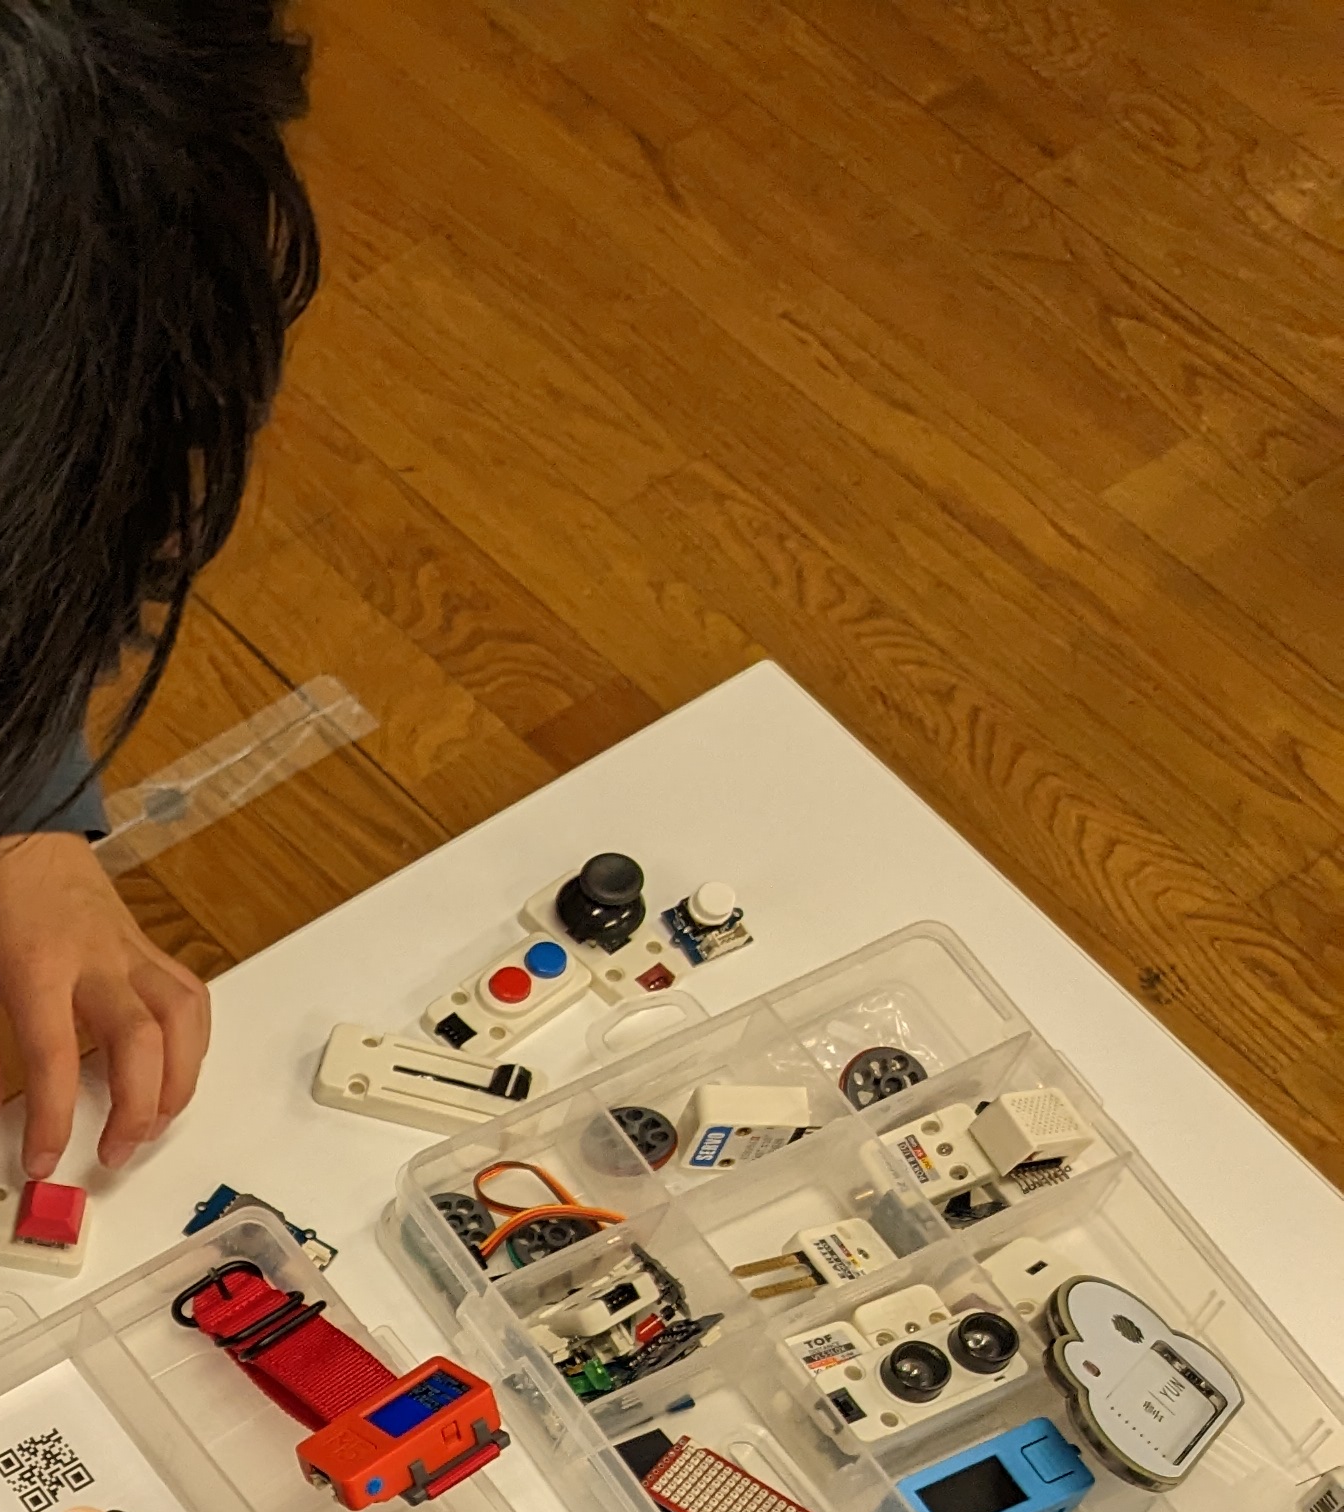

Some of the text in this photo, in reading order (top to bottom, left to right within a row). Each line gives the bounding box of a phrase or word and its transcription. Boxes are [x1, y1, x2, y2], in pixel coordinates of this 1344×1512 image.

[695, 1132, 726, 1161] SERVO
[804, 1333, 833, 1350] TOF
[1159, 1376, 1186, 1402] YUN
